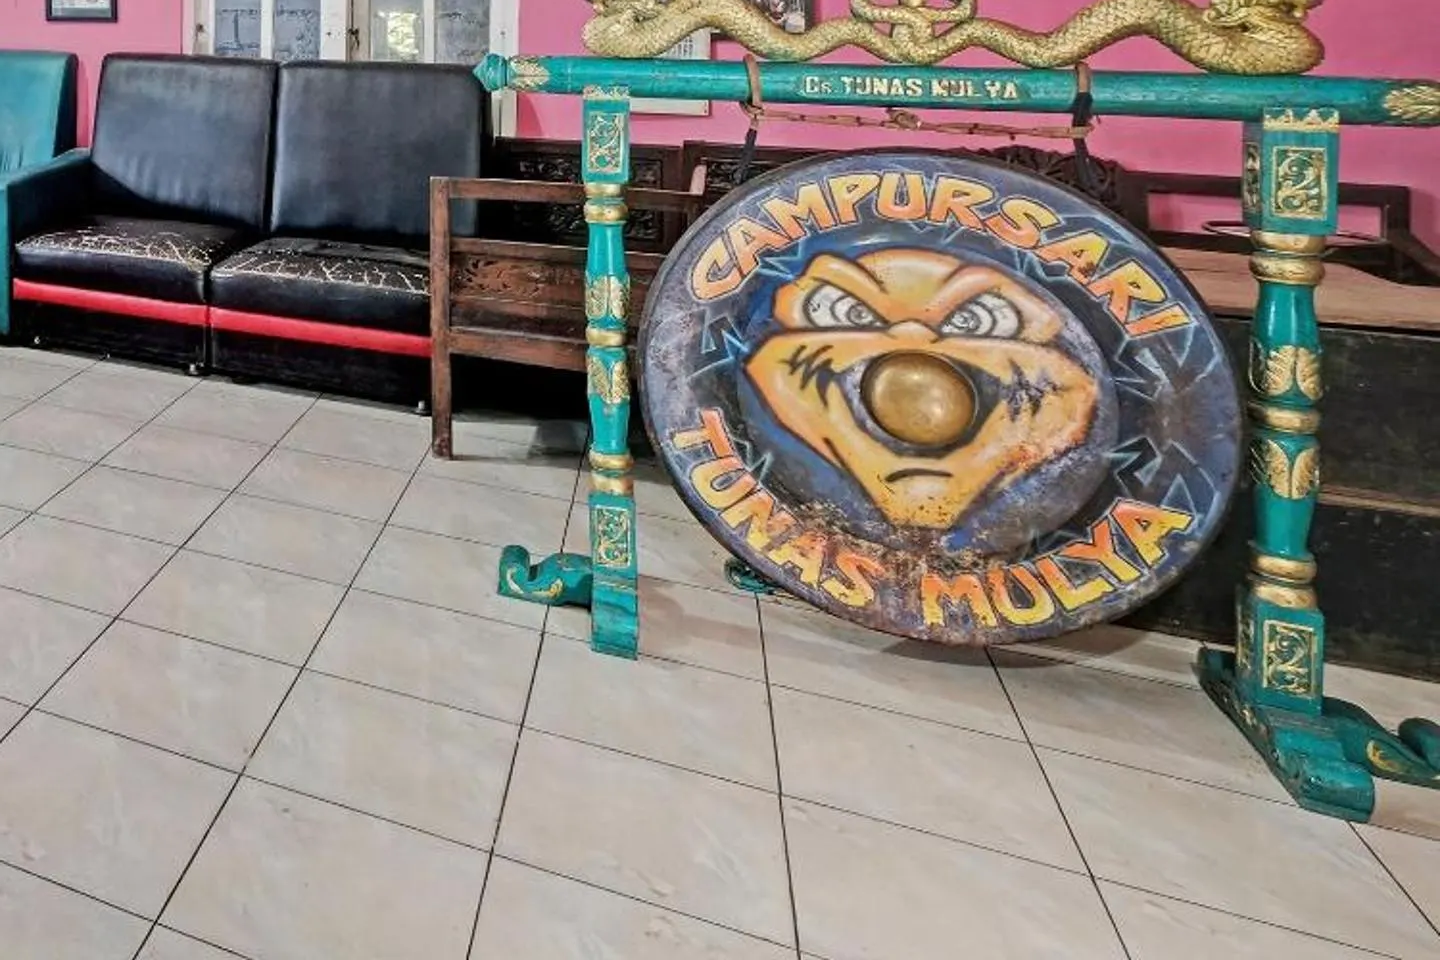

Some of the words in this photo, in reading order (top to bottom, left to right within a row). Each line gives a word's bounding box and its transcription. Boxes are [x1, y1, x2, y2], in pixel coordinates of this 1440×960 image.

[841, 76, 924, 97] TUNAS
[690, 171, 1198, 338] CAMPURSARI
[672, 406, 888, 608] TUNAS
[920, 497, 1195, 629] MULYA
